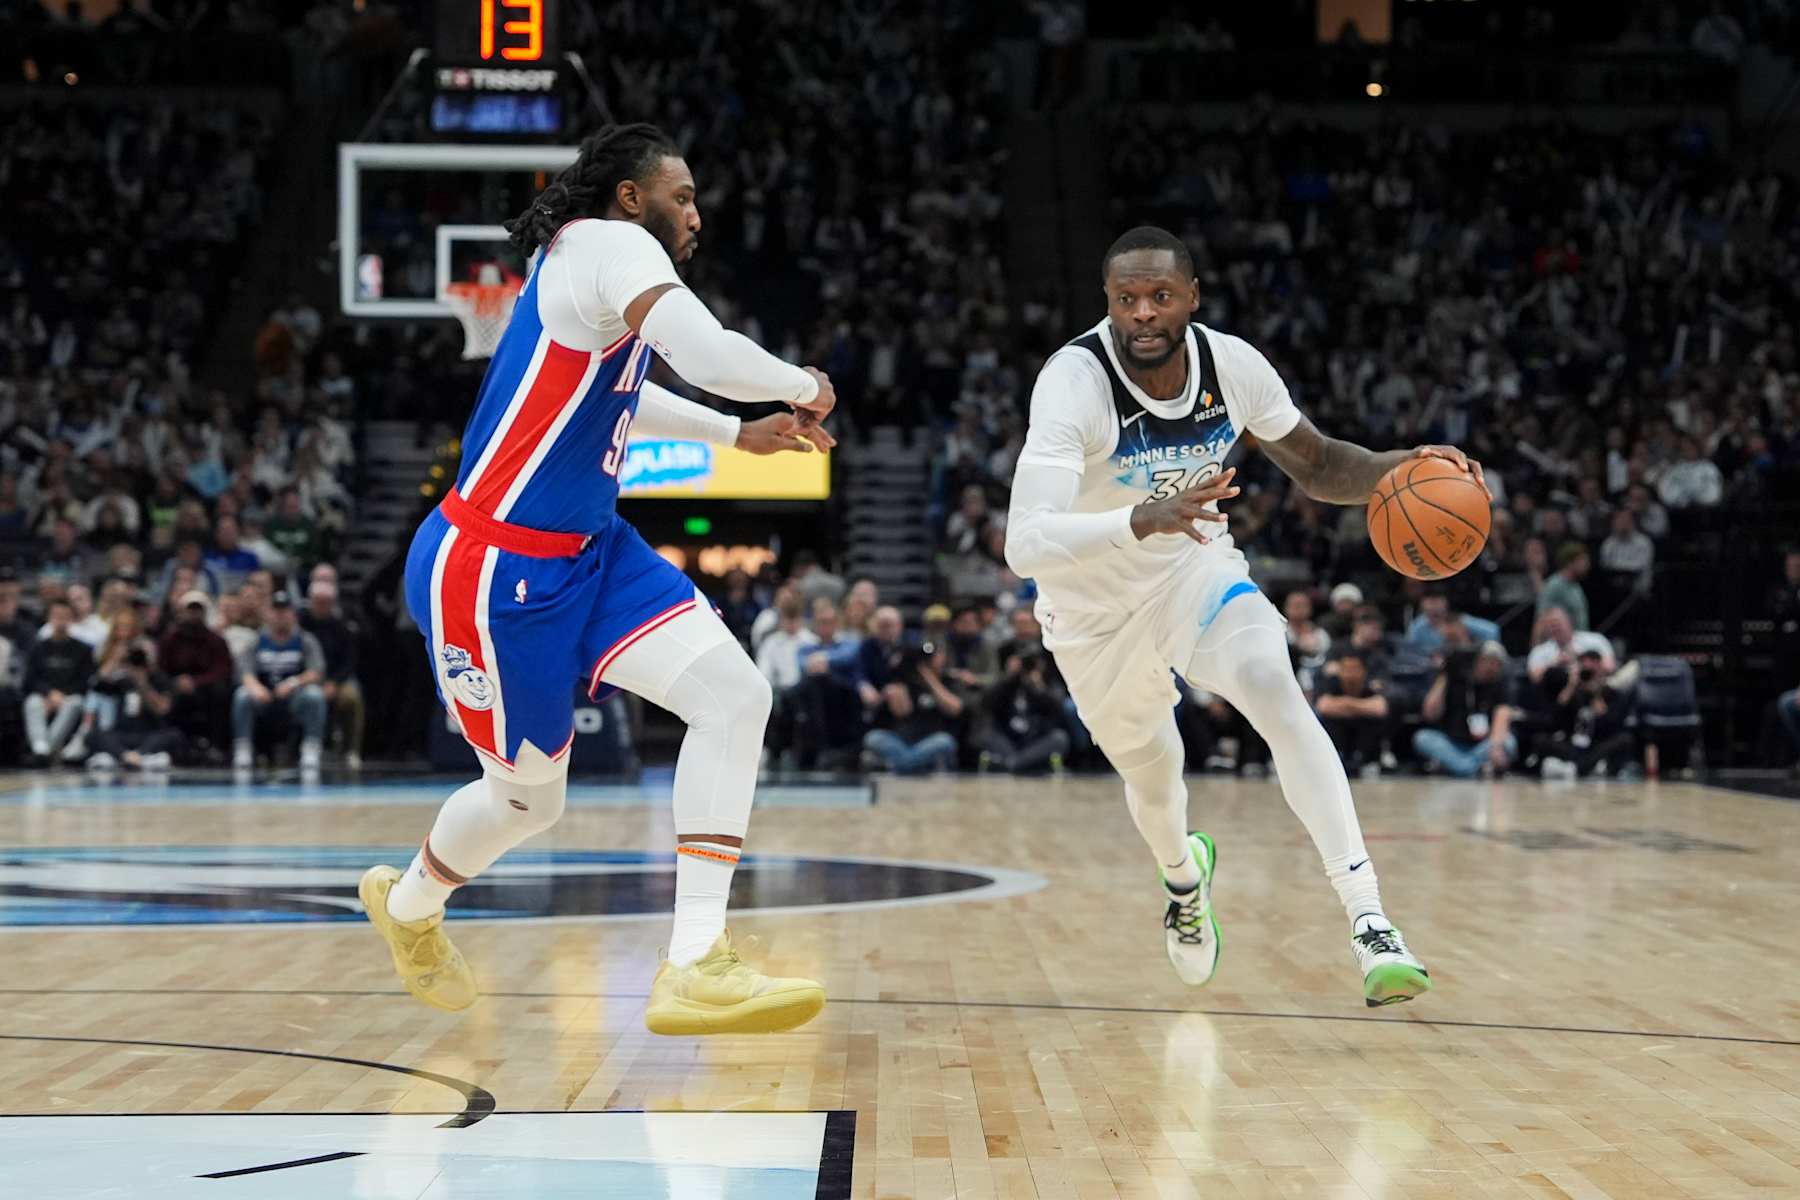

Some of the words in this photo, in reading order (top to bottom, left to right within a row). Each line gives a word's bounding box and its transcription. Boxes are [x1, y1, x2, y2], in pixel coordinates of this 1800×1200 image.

[480, 0, 543, 60] 13
[471, 68, 557, 91] TISSOT
[1194, 404, 1226, 423] sezzle
[1119, 438, 1227, 469] MINNESOTA
